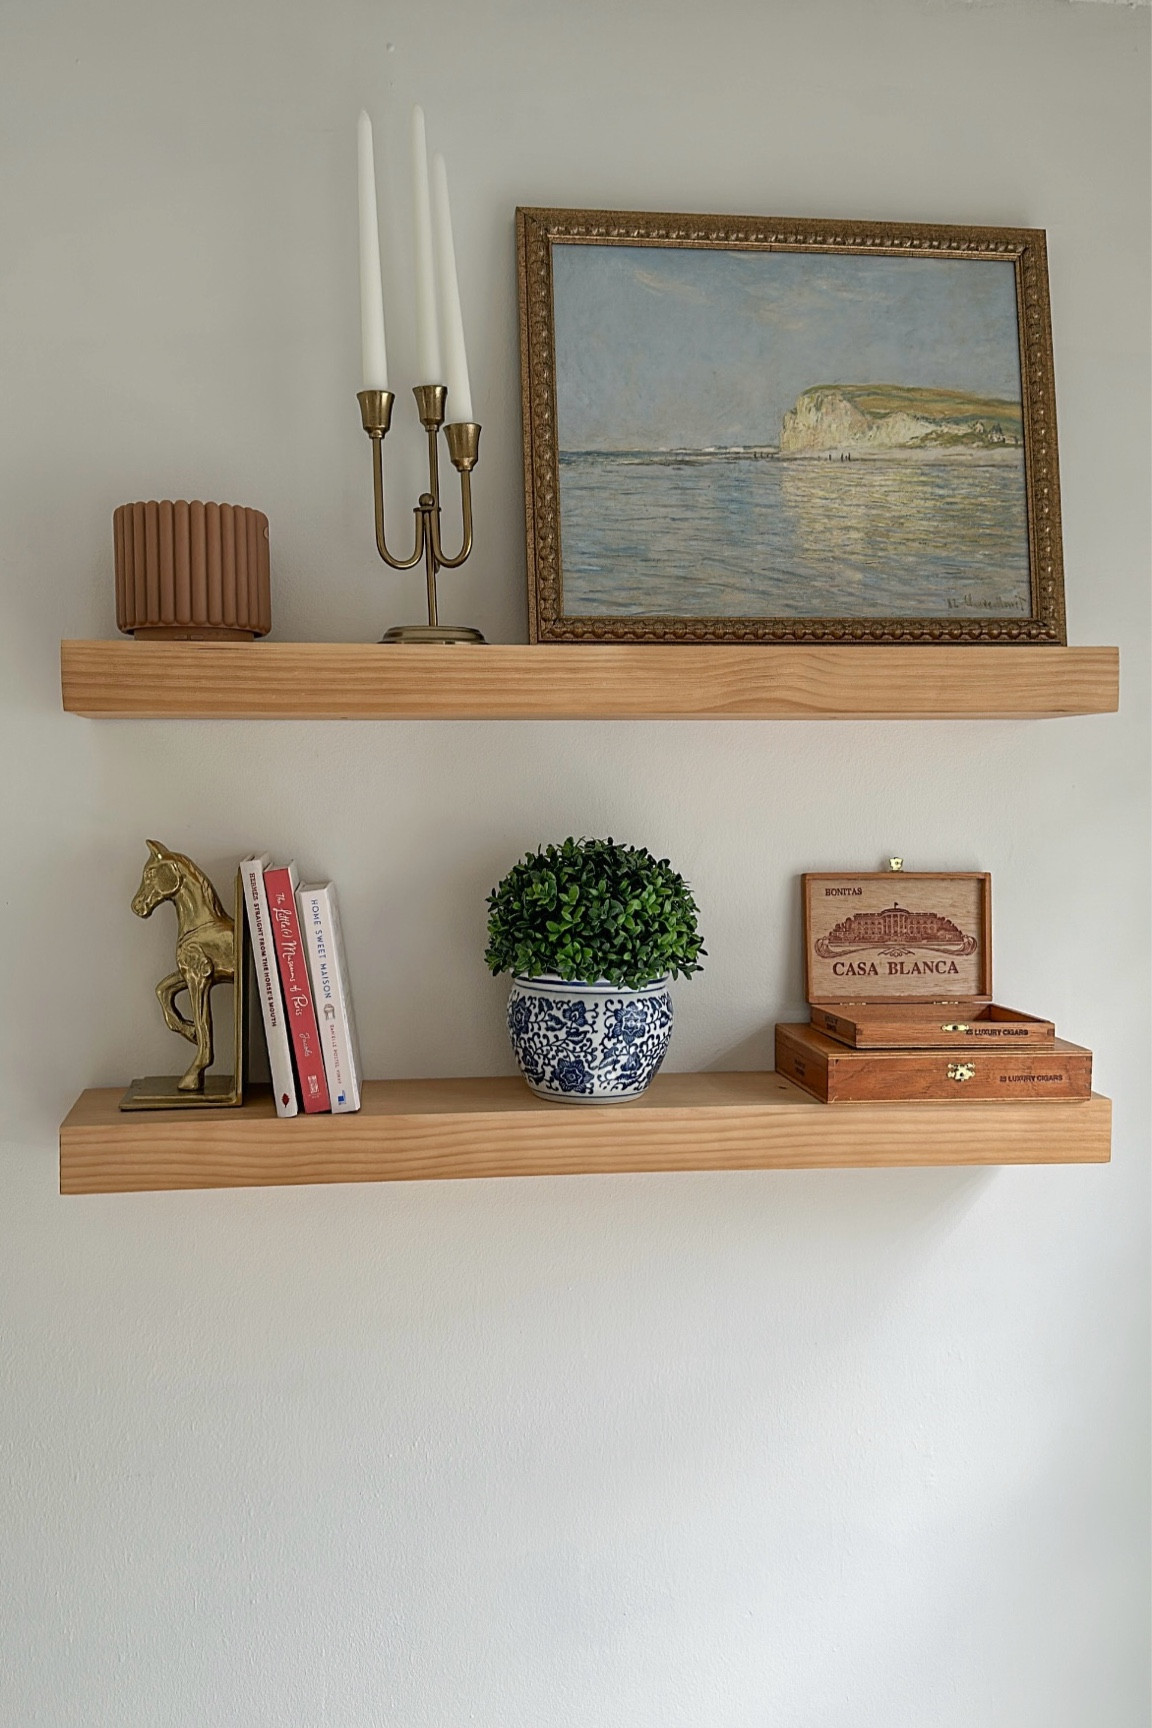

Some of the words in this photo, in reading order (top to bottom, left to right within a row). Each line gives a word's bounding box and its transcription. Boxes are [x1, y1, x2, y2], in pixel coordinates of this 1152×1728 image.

[825, 887, 863, 897] BONITAS
[311, 899, 321, 925] HOME
[276, 893, 285, 904] The
[281, 940, 297, 982] Museums
[291, 993, 308, 1016] Paris
[315, 930, 327, 959] SWEET
[254, 904, 263, 936] STRAIGHT
[268, 1002, 276, 1026] MOUTH
[832, 961, 878, 976] CASA
[887, 960, 960, 976] BLANCA
[320, 963, 332, 999] MAISON
[1002, 1028, 1029, 1036] CIGARS
